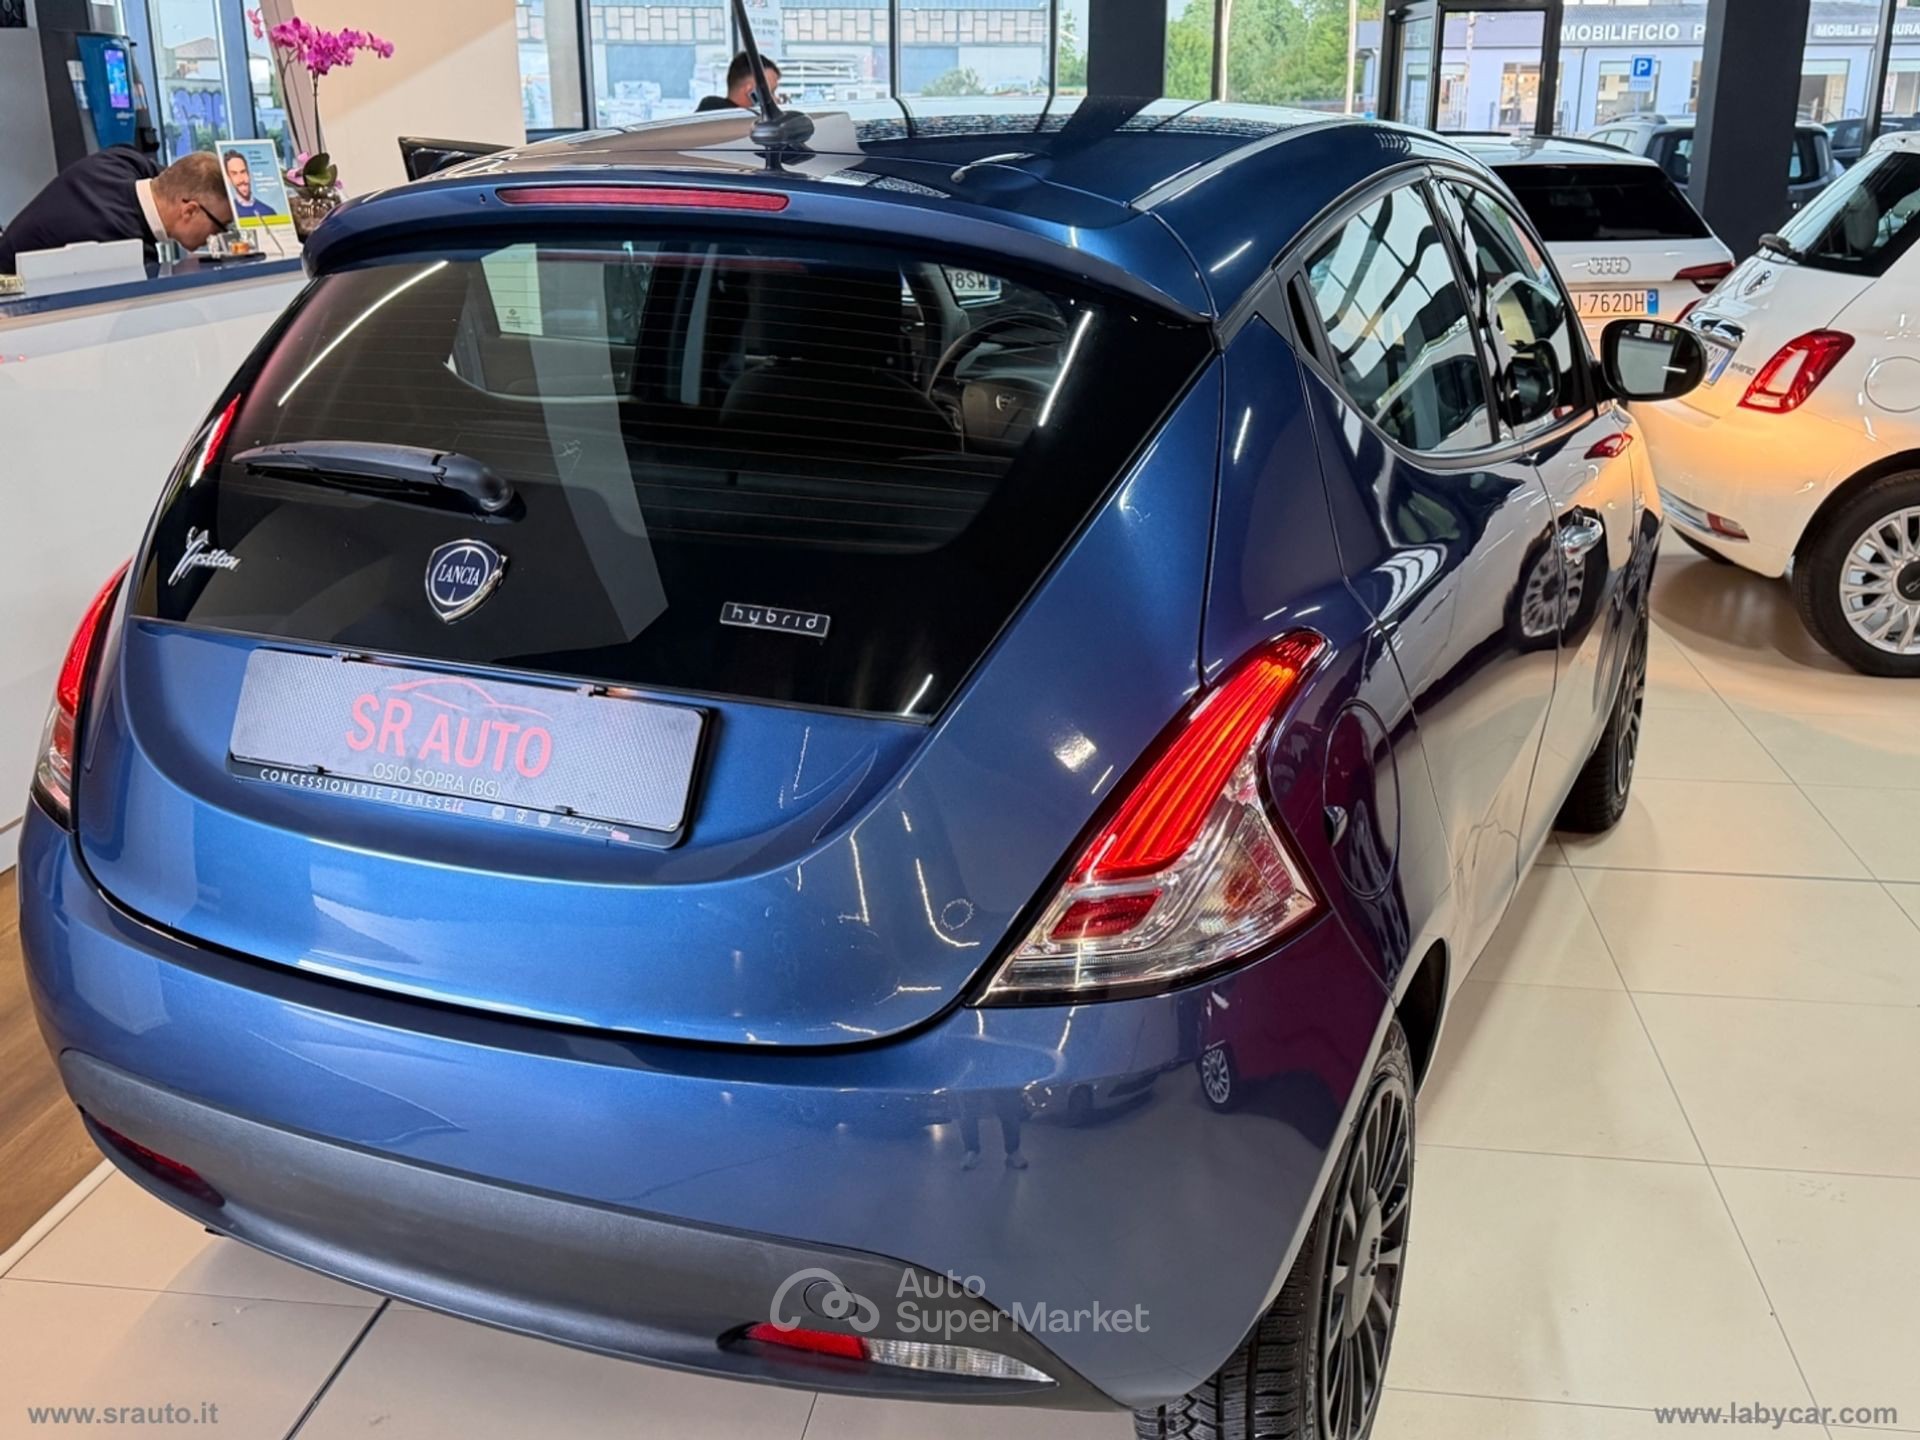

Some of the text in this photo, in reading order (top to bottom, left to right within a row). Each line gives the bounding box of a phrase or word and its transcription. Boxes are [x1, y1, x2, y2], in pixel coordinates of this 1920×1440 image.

[1560, 24, 1680, 41] MOBILIFICIO
[1815, 23, 1859, 36] MOBILI
[1635, 60, 1649, 75] P
[1589, 293, 1645, 313] 762DH
[437, 563, 480, 586] LANCIA
[731, 604, 819, 629] hybrid
[345, 693, 553, 778] SR AUTO
[260, 768, 384, 800] CONCESSIONARIE
[373, 762, 501, 798] OSIO SOPRA (BG)
